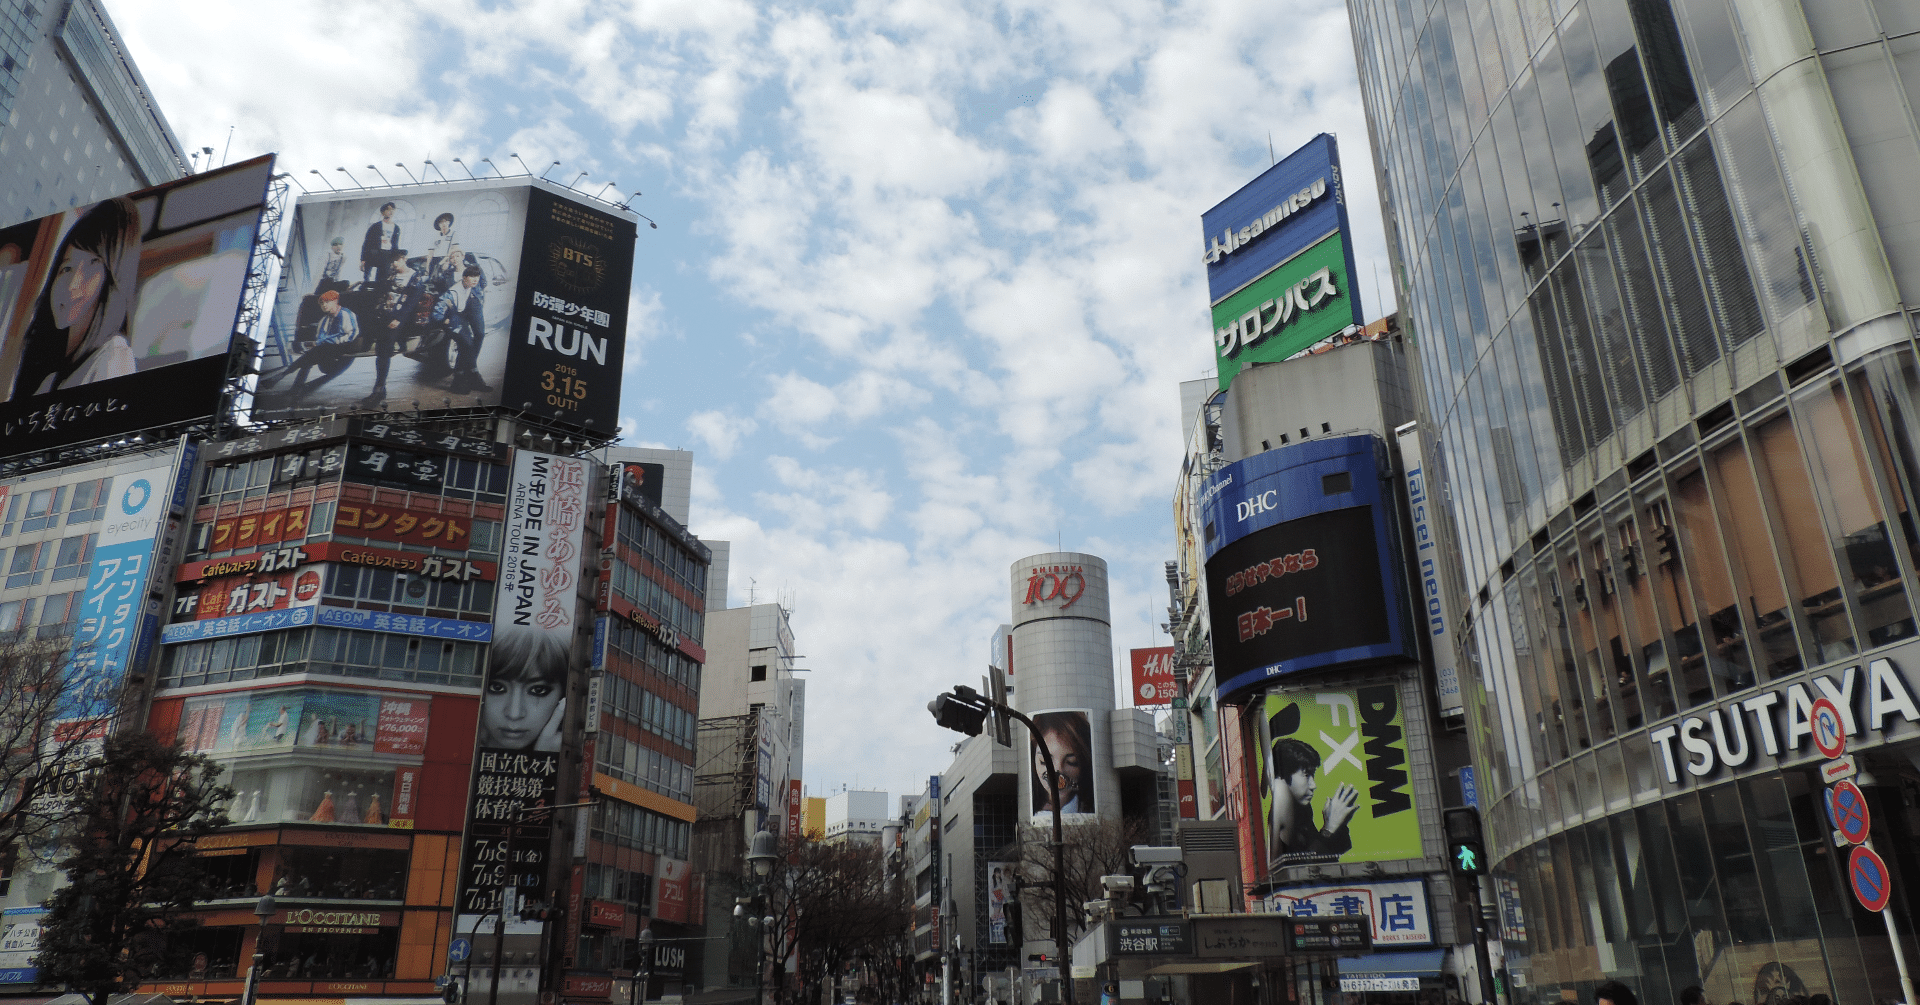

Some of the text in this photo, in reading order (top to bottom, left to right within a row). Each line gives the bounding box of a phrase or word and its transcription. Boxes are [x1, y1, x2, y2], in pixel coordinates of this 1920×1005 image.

[1201, 176, 1326, 265] Hisamitsu
[563, 247, 593, 267] BTS
[533, 290, 610, 328] 防彈少年團
[1215, 265, 1336, 357] サロンパス
[527, 316, 608, 366] RUN
[555, 363, 577, 376] 2016
[541, 370, 587, 399] 3.15
[547, 394, 578, 411] OUT!
[5, 398, 128, 436] いち髪なひと。
[218, 437, 261, 456] 月の宴
[282, 426, 324, 442] 月の宴
[365, 424, 423, 446] 月の宴
[438, 436, 494, 456] 月の宴
[282, 451, 342, 477] 月の宴
[361, 451, 439, 482] 月の宴
[1209, 473, 1233, 498] Channel
[512, 482, 526, 520] ARENA
[1236, 490, 1278, 522] DHC
[108, 517, 151, 537] eyecity
[214, 509, 307, 545] プライス
[338, 505, 468, 542] コンタクト
[508, 523, 522, 553] TOUR
[522, 535, 540, 556] IN
[1406, 460, 1445, 636] Taisei neon
[257, 548, 308, 573] ガスト
[420, 557, 482, 581] ガスト
[505, 556, 518, 580] 2016
[1033, 565, 1084, 575] SHIBUYA
[1225, 549, 1319, 596] どうせやるなら
[226, 580, 288, 615] ガスト
[513, 559, 537, 626] JAPAN
[1022, 572, 1086, 609] 109
[176, 595, 199, 614] 7F
[203, 612, 286, 637] 英会話イーオン
[322, 609, 488, 638] AEON 英会話イーオン
[658, 624, 681, 650] ガスト
[1266, 664, 1283, 676] DHC
[382, 701, 413, 716] 沖縄
[1651, 657, 1920, 784] TSUTAYA
[1316, 692, 1363, 776] FX
[479, 752, 557, 776] 国立代々木
[1356, 684, 1412, 819] DMM
[397, 771, 414, 814] 毎日開催
[477, 774, 555, 799] 競技場第一
[474, 798, 525, 822] 体育館
[286, 908, 381, 926] L'OCCITANE
[10, 928, 38, 938] ハチ公前
[302, 926, 363, 934] EN PROVENCE
[1119, 937, 1158, 952] 渋谷駅
[1204, 936, 1252, 950] しぶちか
[654, 946, 685, 969] LUSH
